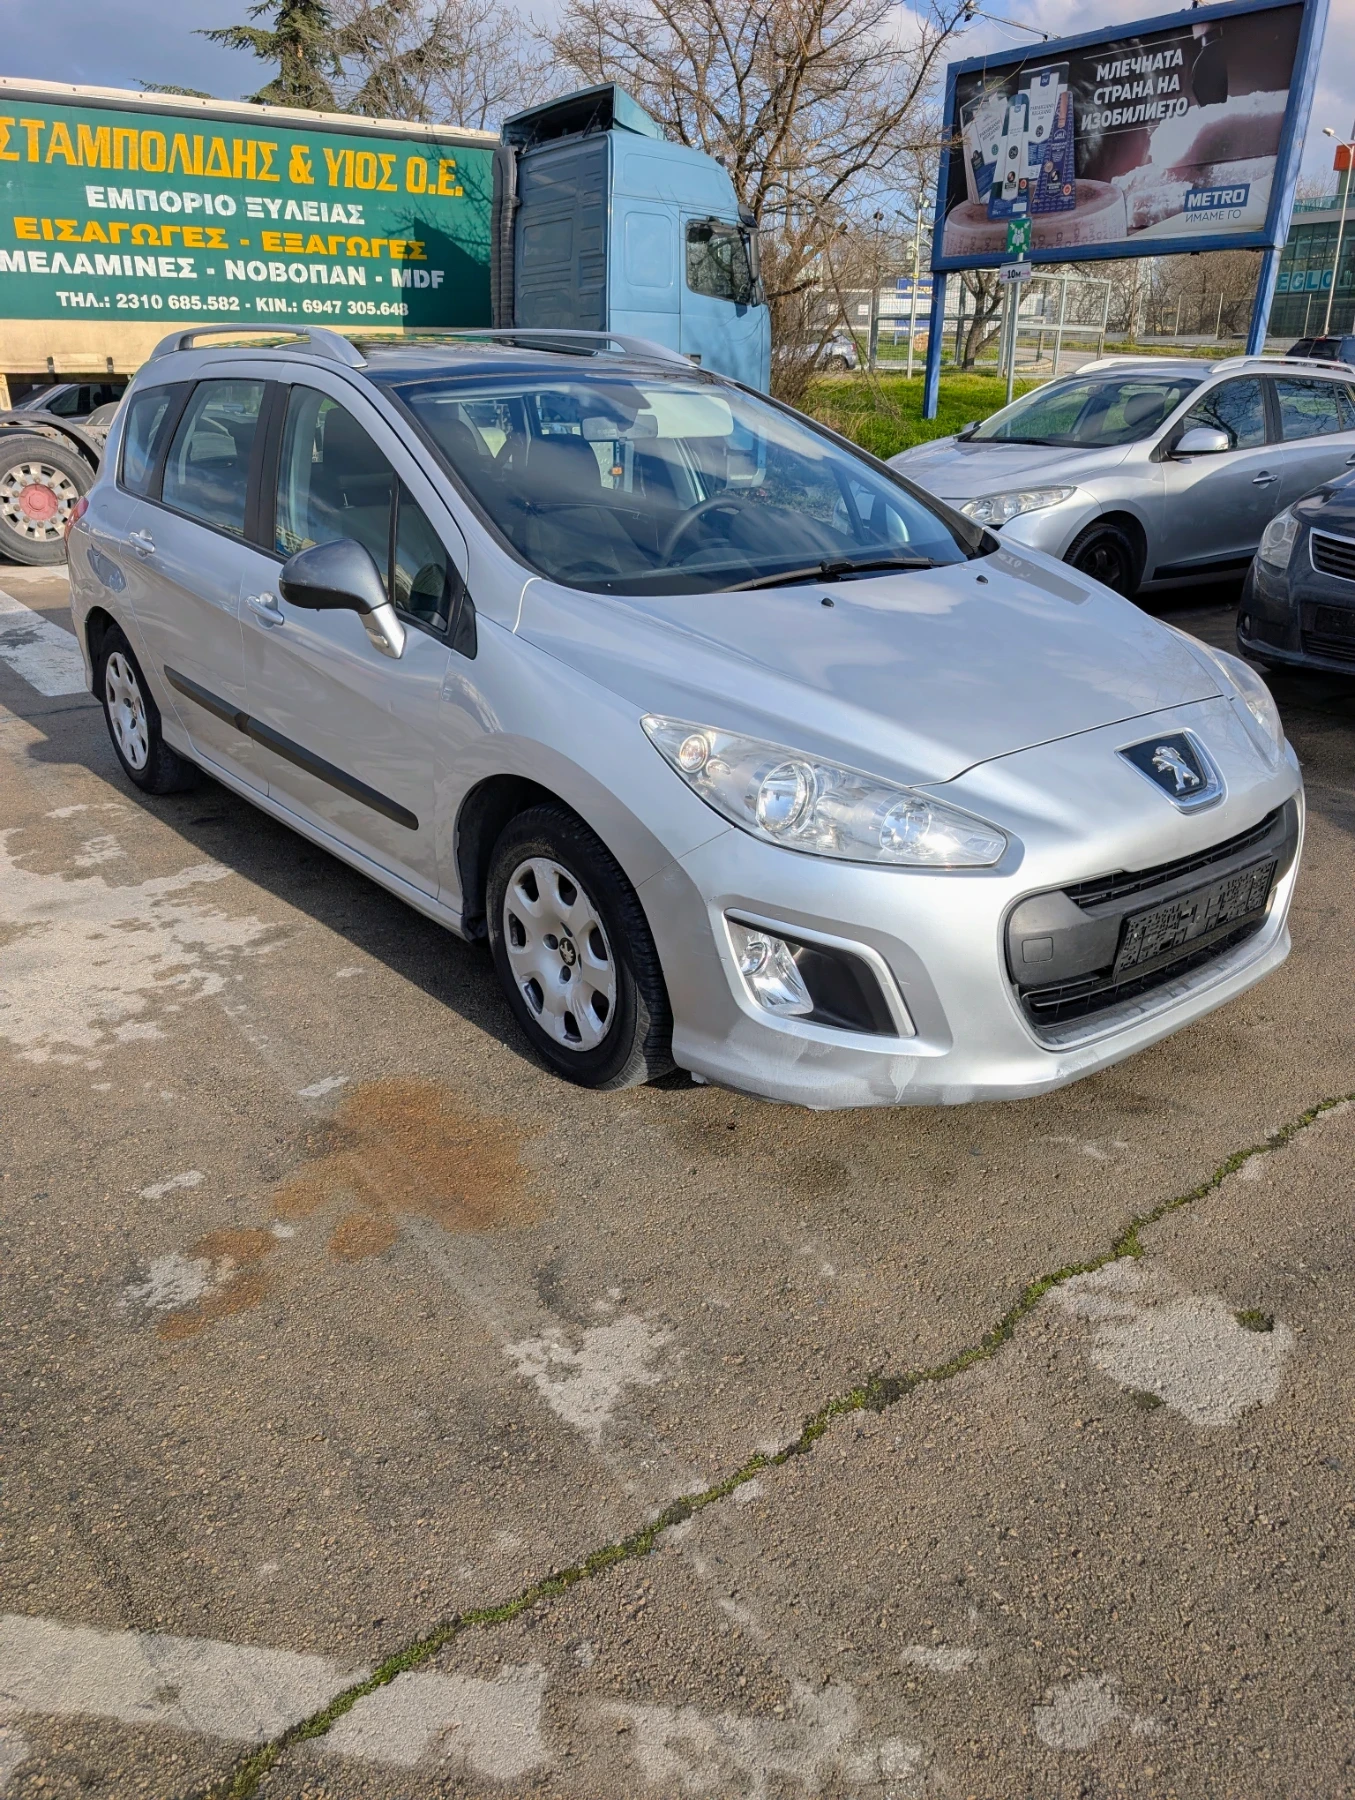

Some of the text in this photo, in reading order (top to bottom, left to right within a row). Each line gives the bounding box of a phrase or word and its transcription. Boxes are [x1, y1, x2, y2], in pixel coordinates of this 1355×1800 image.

[1096, 48, 1183, 82] МЛЕЧНАТА
[1093, 74, 1180, 105] СТРАНА НА
[1081, 97, 1188, 131] ИЗОБИЛИЕТО
[0, 116, 464, 197] ΣΤΑΜΠΟΛΙΔΗΣ & ΥΙΟΣ Ο.Ε.
[85, 185, 365, 225] ΕΜΠΟΡΙΟ ΞΥΛΕΙΑΣ
[1187, 189, 1246, 208] METRO
[1185, 209, 1242, 223] ИМАМЕ ГО
[13, 216, 229, 249] ΕΙΣΑΓΩΓΕΣ
[261, 231, 428, 260] ΕΞΑΓΩΓΕΣ
[0, 249, 197, 278] ΜΕΛΑΜΙΝΕΣ
[224, 259, 366, 286] ΝΟΒΟΠΑΝ
[391, 267, 445, 289] MDF
[56, 291, 110, 308] ΤΗΛ.:
[116, 294, 163, 309] 2310
[168, 295, 240, 311] 685.582
[256, 297, 297, 313] ΚΙΝ.:
[302, 299, 342, 314] 6947
[347, 301, 409, 316] 305.648
